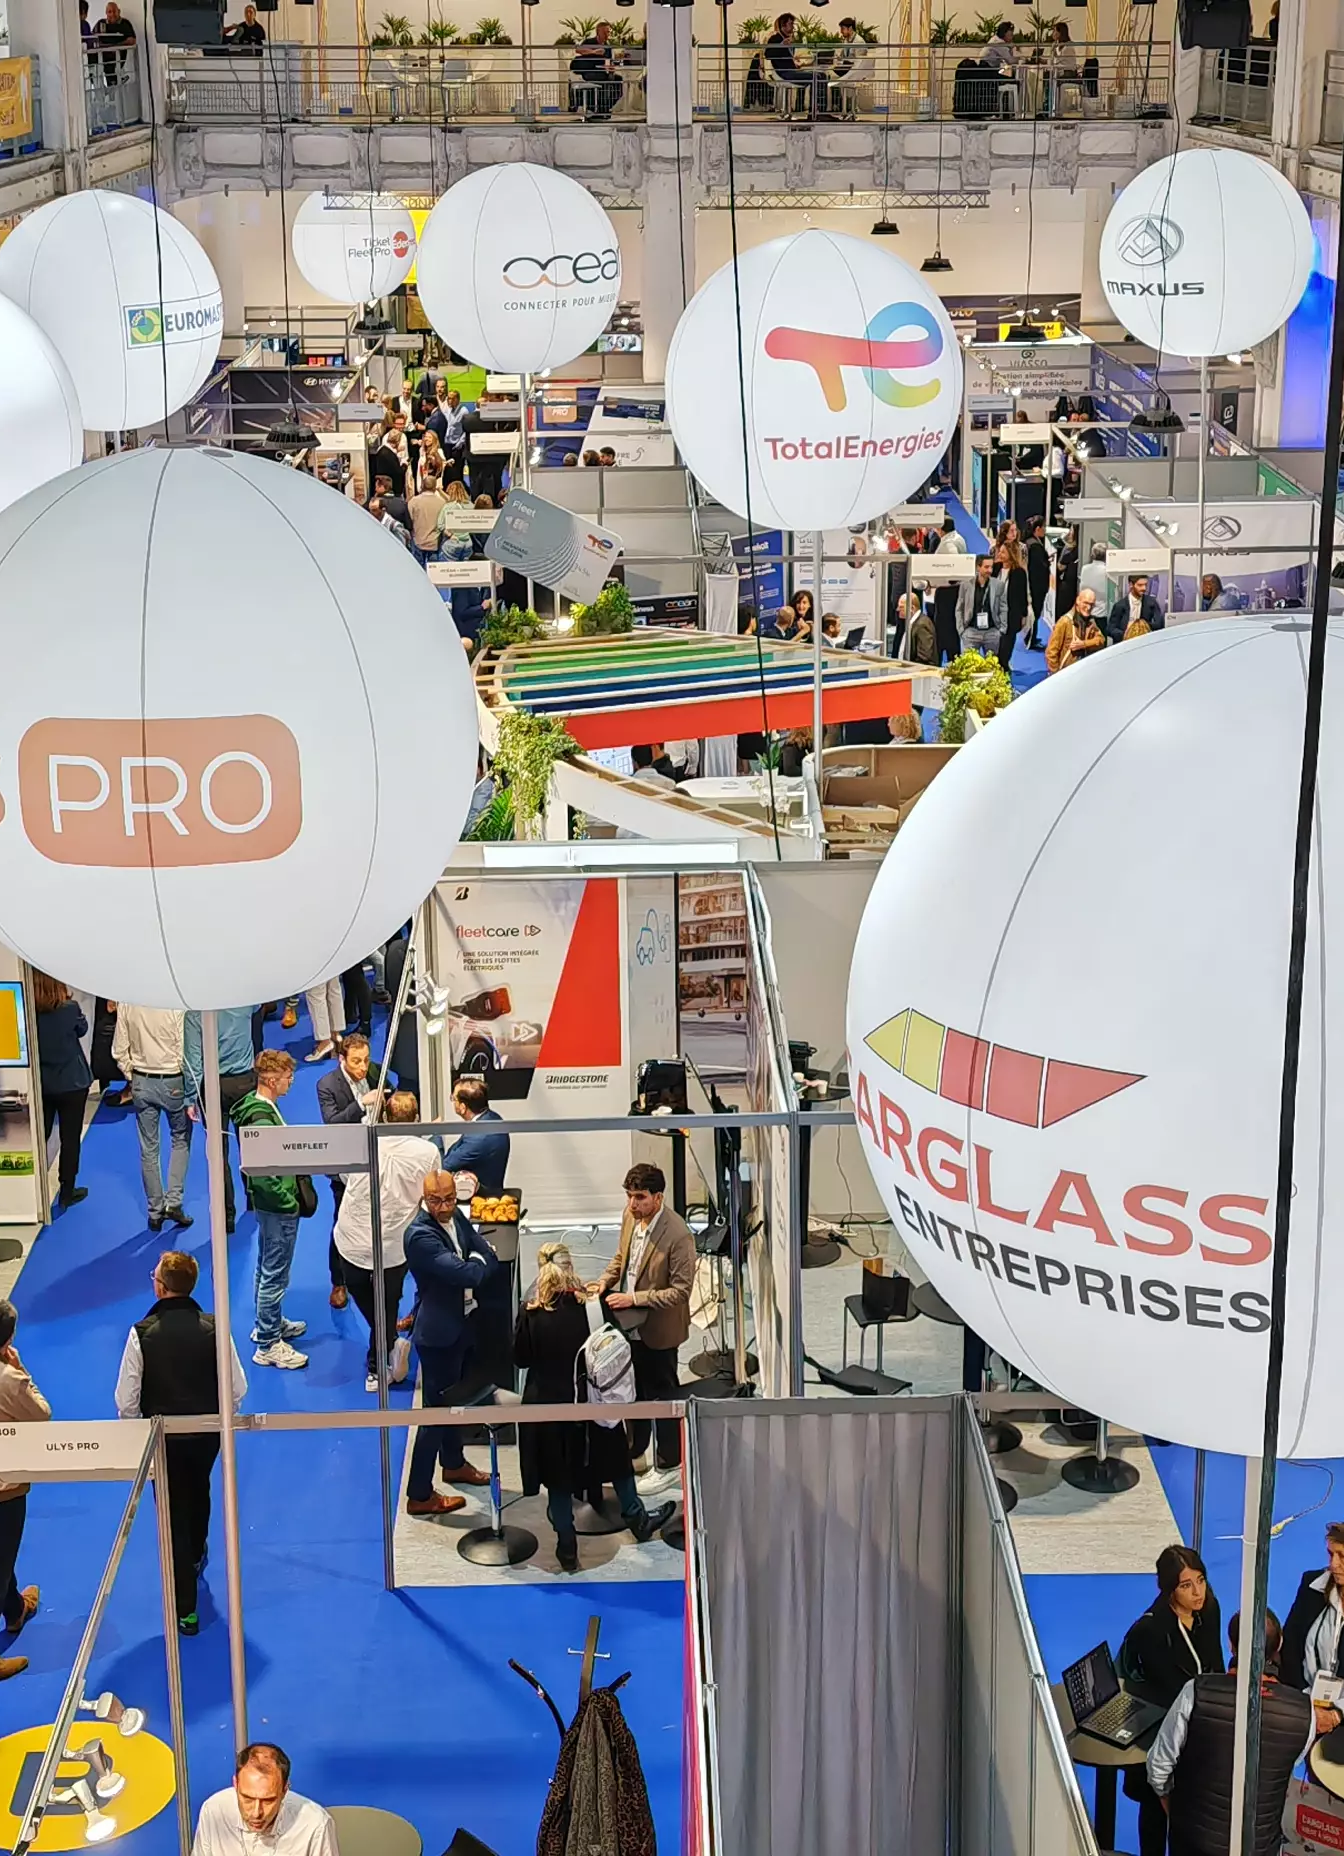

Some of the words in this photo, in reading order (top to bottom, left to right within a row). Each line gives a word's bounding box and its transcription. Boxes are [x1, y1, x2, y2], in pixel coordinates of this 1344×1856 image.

[363, 237, 390, 247] Ticket
[348, 248, 372, 258] Fleet
[374, 248, 390, 257] Pro
[1107, 281, 1204, 296] MAXUS
[504, 300, 567, 311] CONNECTER
[573, 297, 594, 307] POUR
[764, 427, 943, 460] TotalEnergies
[48, 750, 272, 837] PRO
[456, 925, 520, 938] fleetcare
[510, 948, 539, 956] INTÉGRÉE
[463, 963, 504, 971] ÉLECTRIQUES
[545, 1074, 609, 1084] BRIDGESTONE
[283, 1142, 328, 1150] WEBFLEET
[856, 1069, 1273, 1267] ARGLASS
[894, 1184, 1272, 1333] ENTREPRISES
[46, 1442, 74, 1452] ULYS
[77, 1441, 100, 1451] PRO
